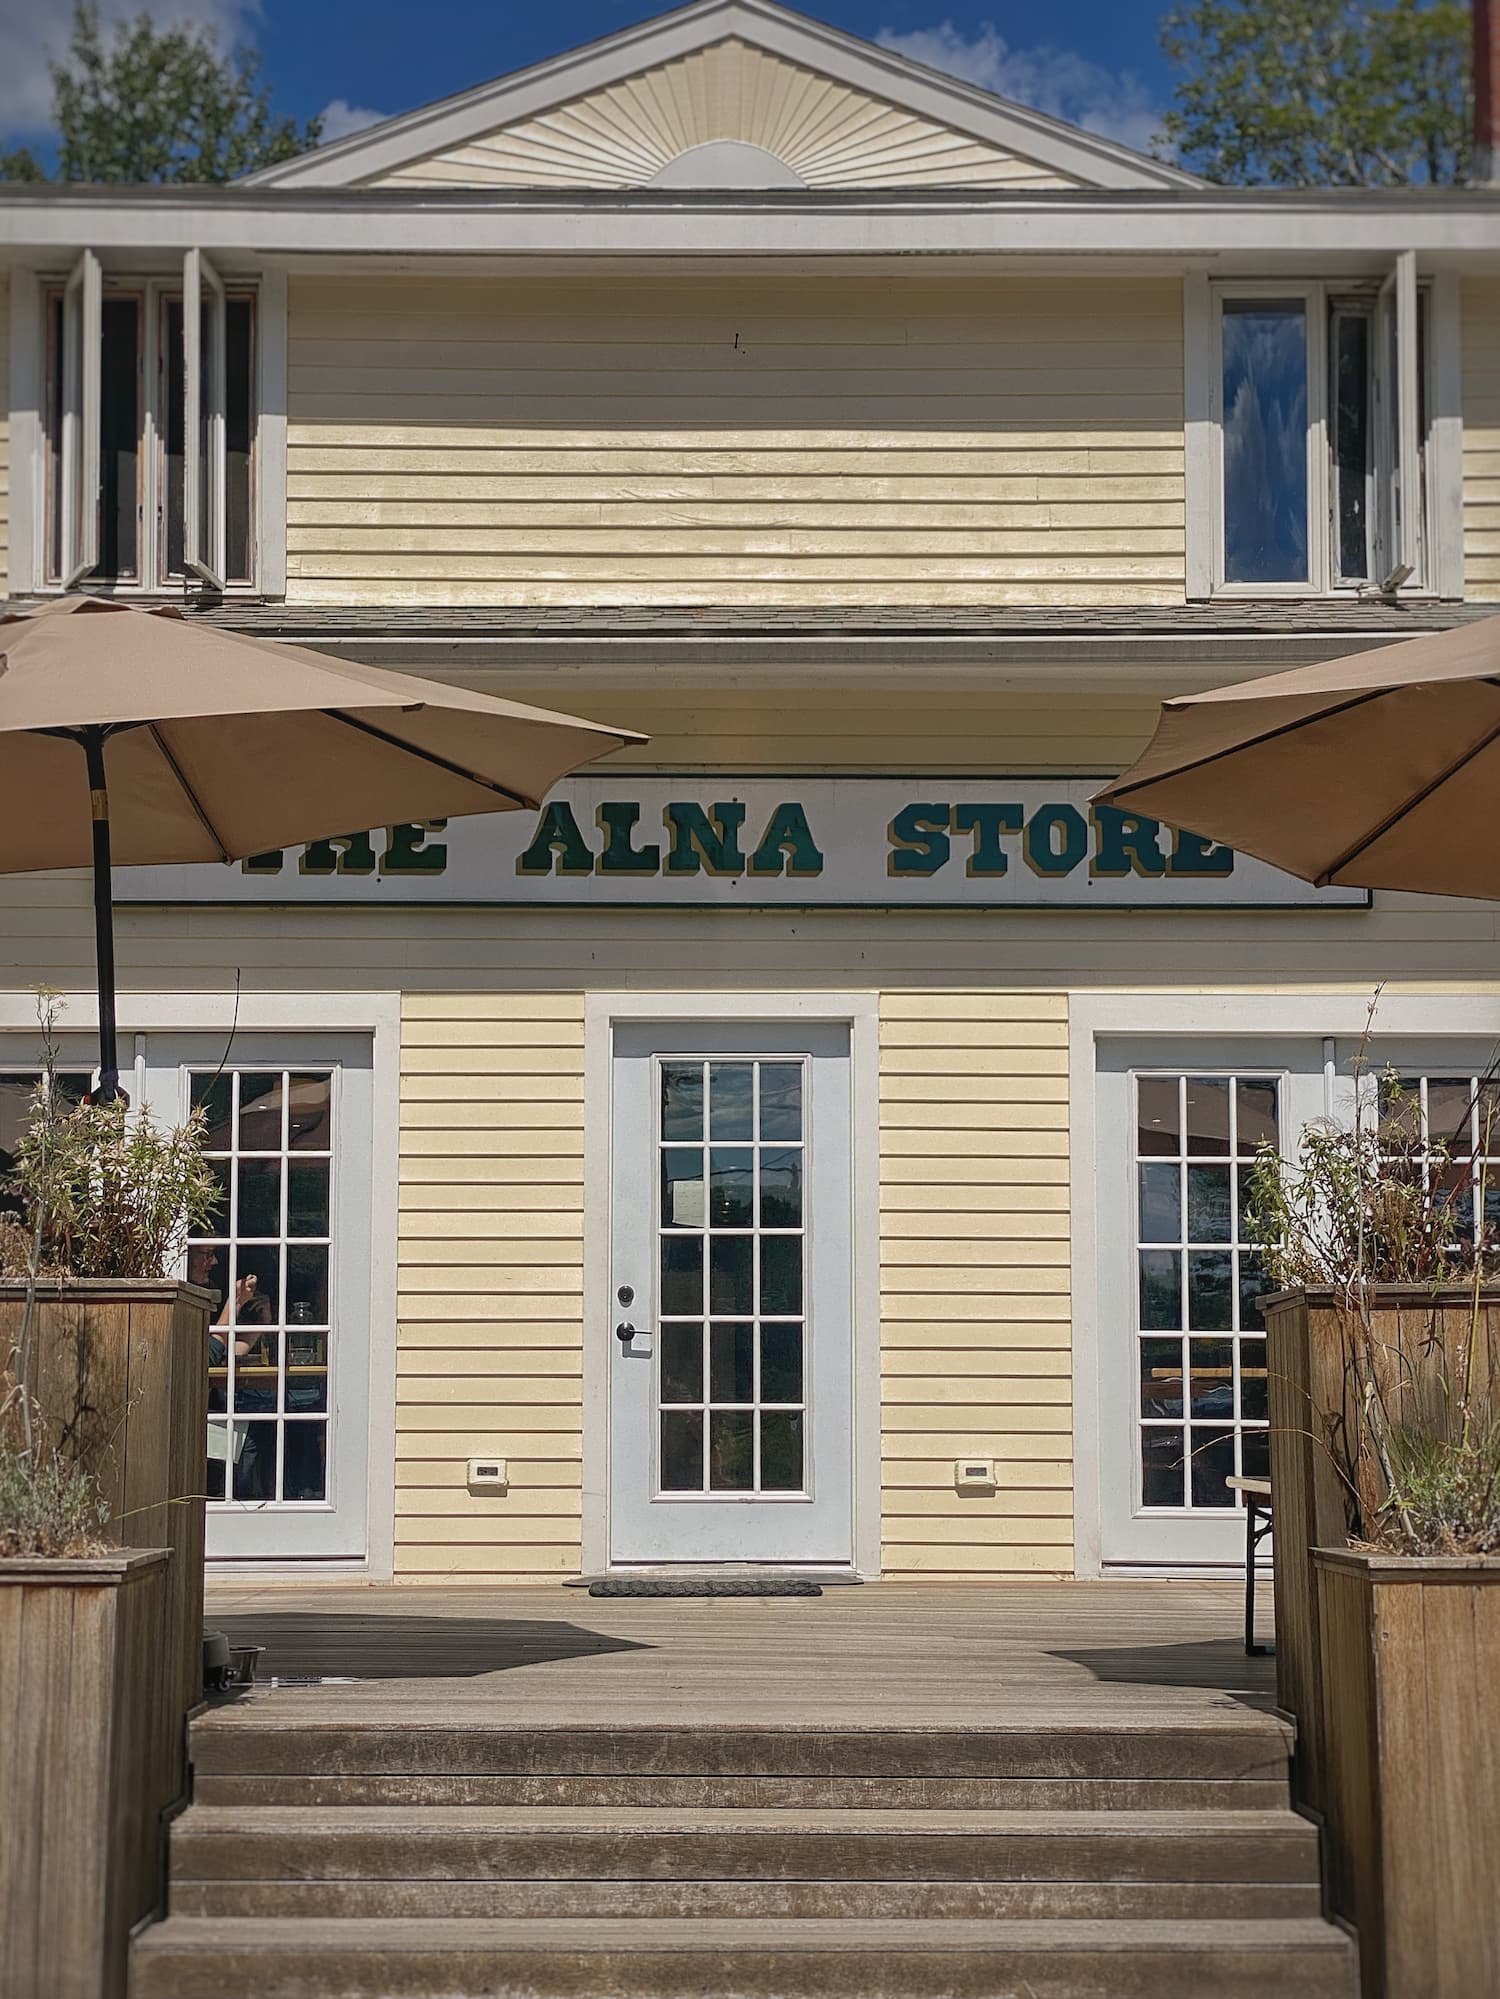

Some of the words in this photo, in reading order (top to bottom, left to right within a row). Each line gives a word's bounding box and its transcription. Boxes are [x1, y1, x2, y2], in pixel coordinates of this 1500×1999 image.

[242, 817, 448, 875] HE
[515, 801, 824, 877] ALNA
[887, 803, 1234, 878] STORE
